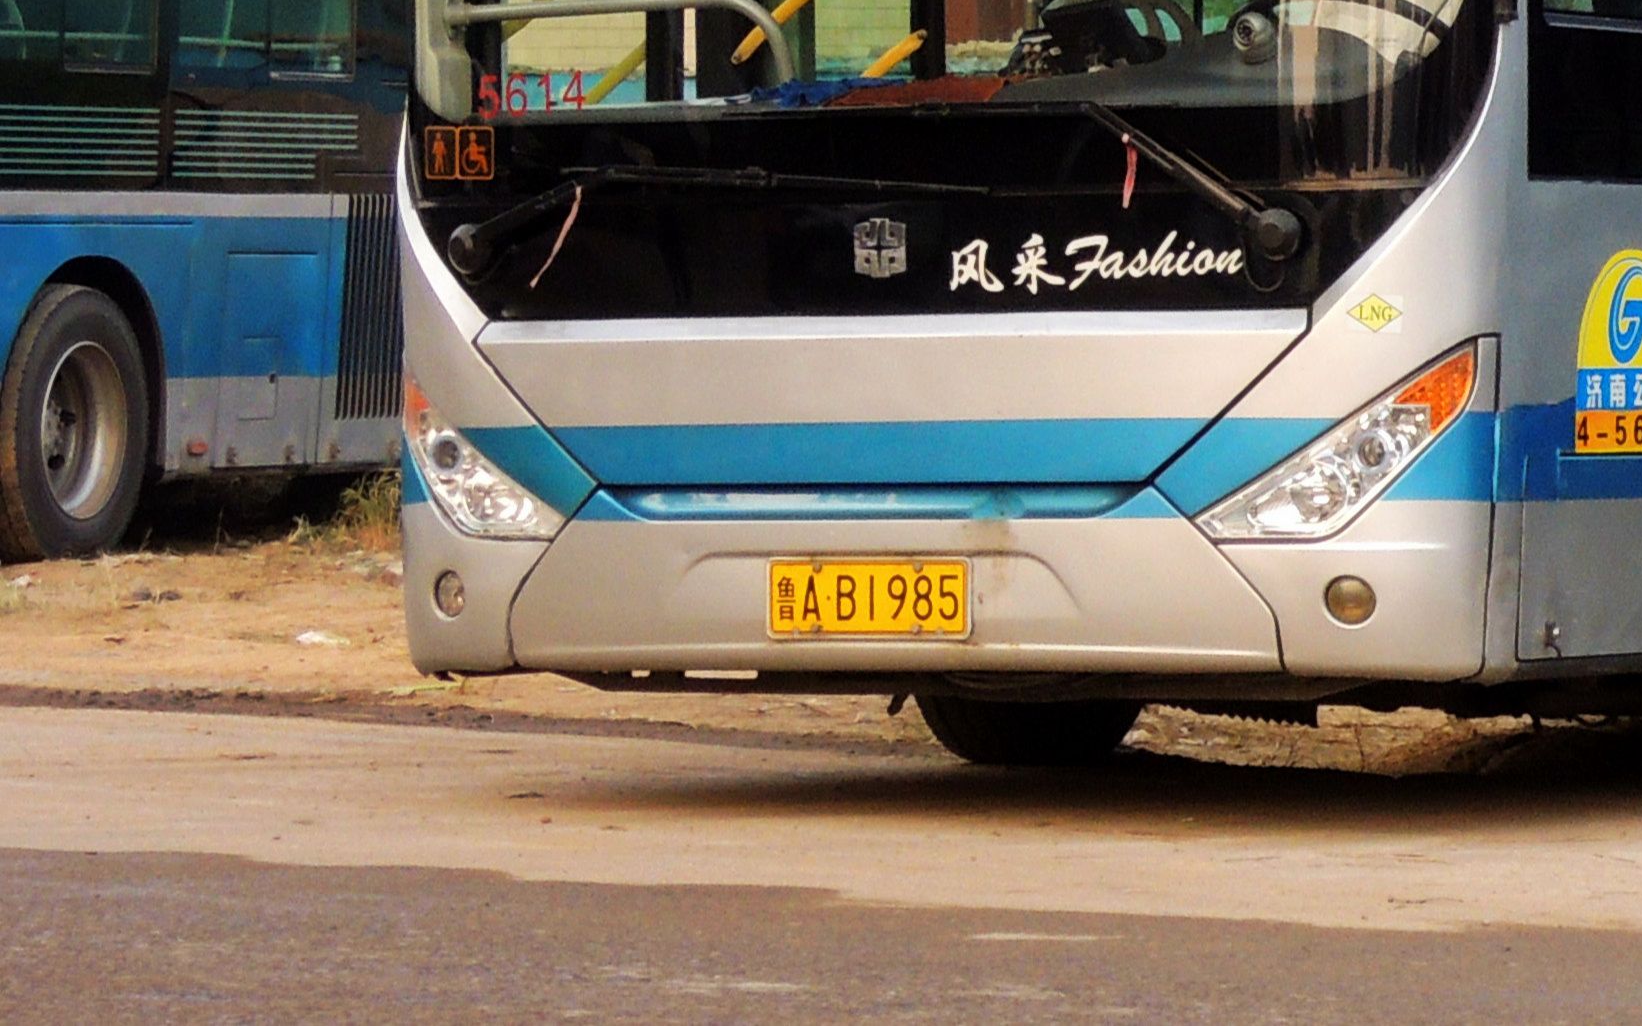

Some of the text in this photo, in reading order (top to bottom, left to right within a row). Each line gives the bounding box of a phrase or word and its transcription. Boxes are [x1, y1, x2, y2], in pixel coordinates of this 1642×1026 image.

[478, 69, 586, 119] 5614
[949, 229, 1243, 295] 风采 Fashion
[1359, 304, 1393, 322] LNG
